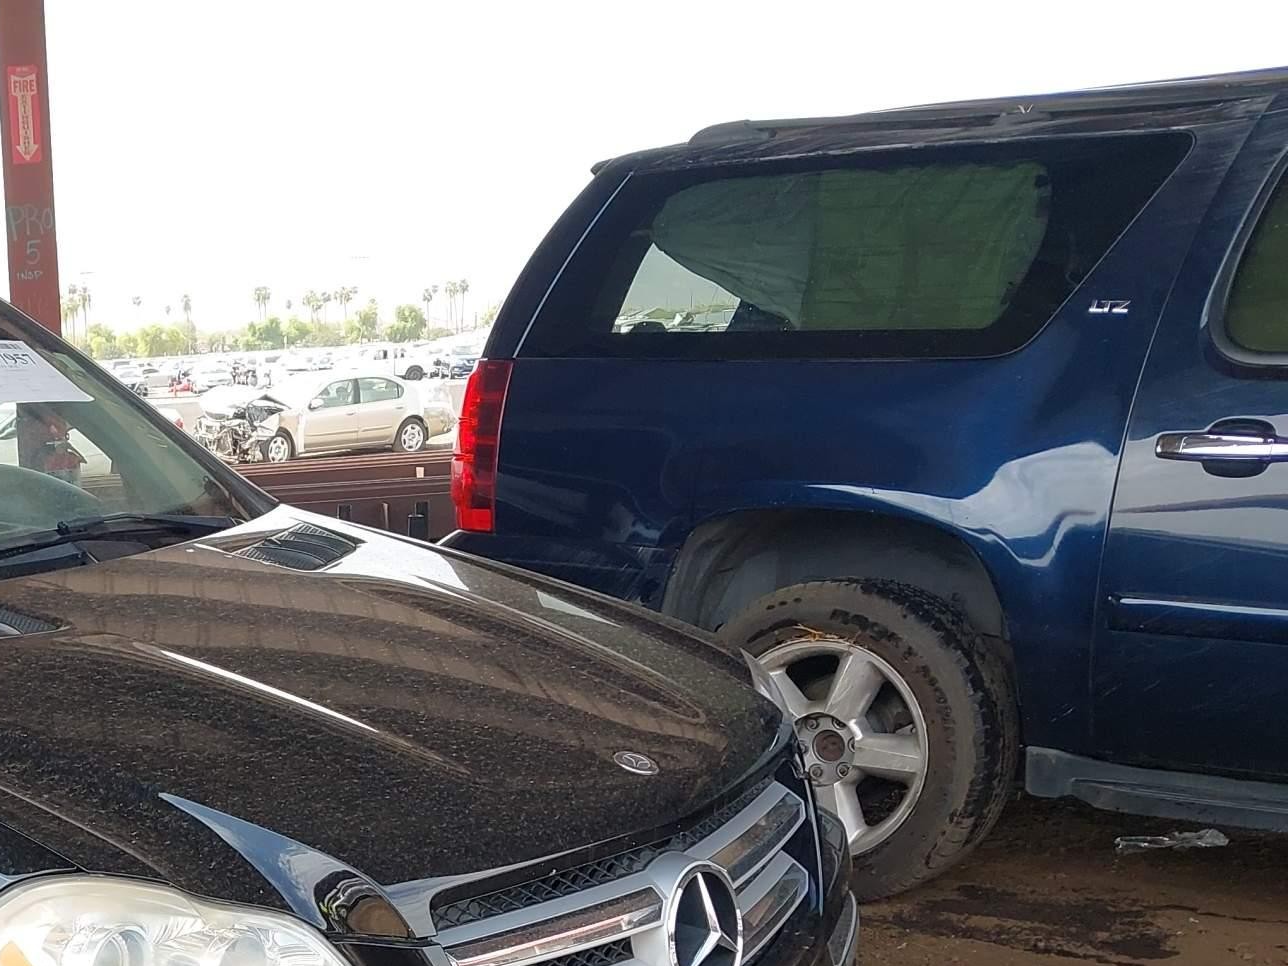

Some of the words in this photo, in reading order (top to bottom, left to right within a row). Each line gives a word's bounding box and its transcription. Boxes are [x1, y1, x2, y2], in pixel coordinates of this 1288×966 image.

[13, 79, 36, 93] FIRE
[26, 239, 41, 265] 5
[1088, 300, 1131, 313] LTZ
